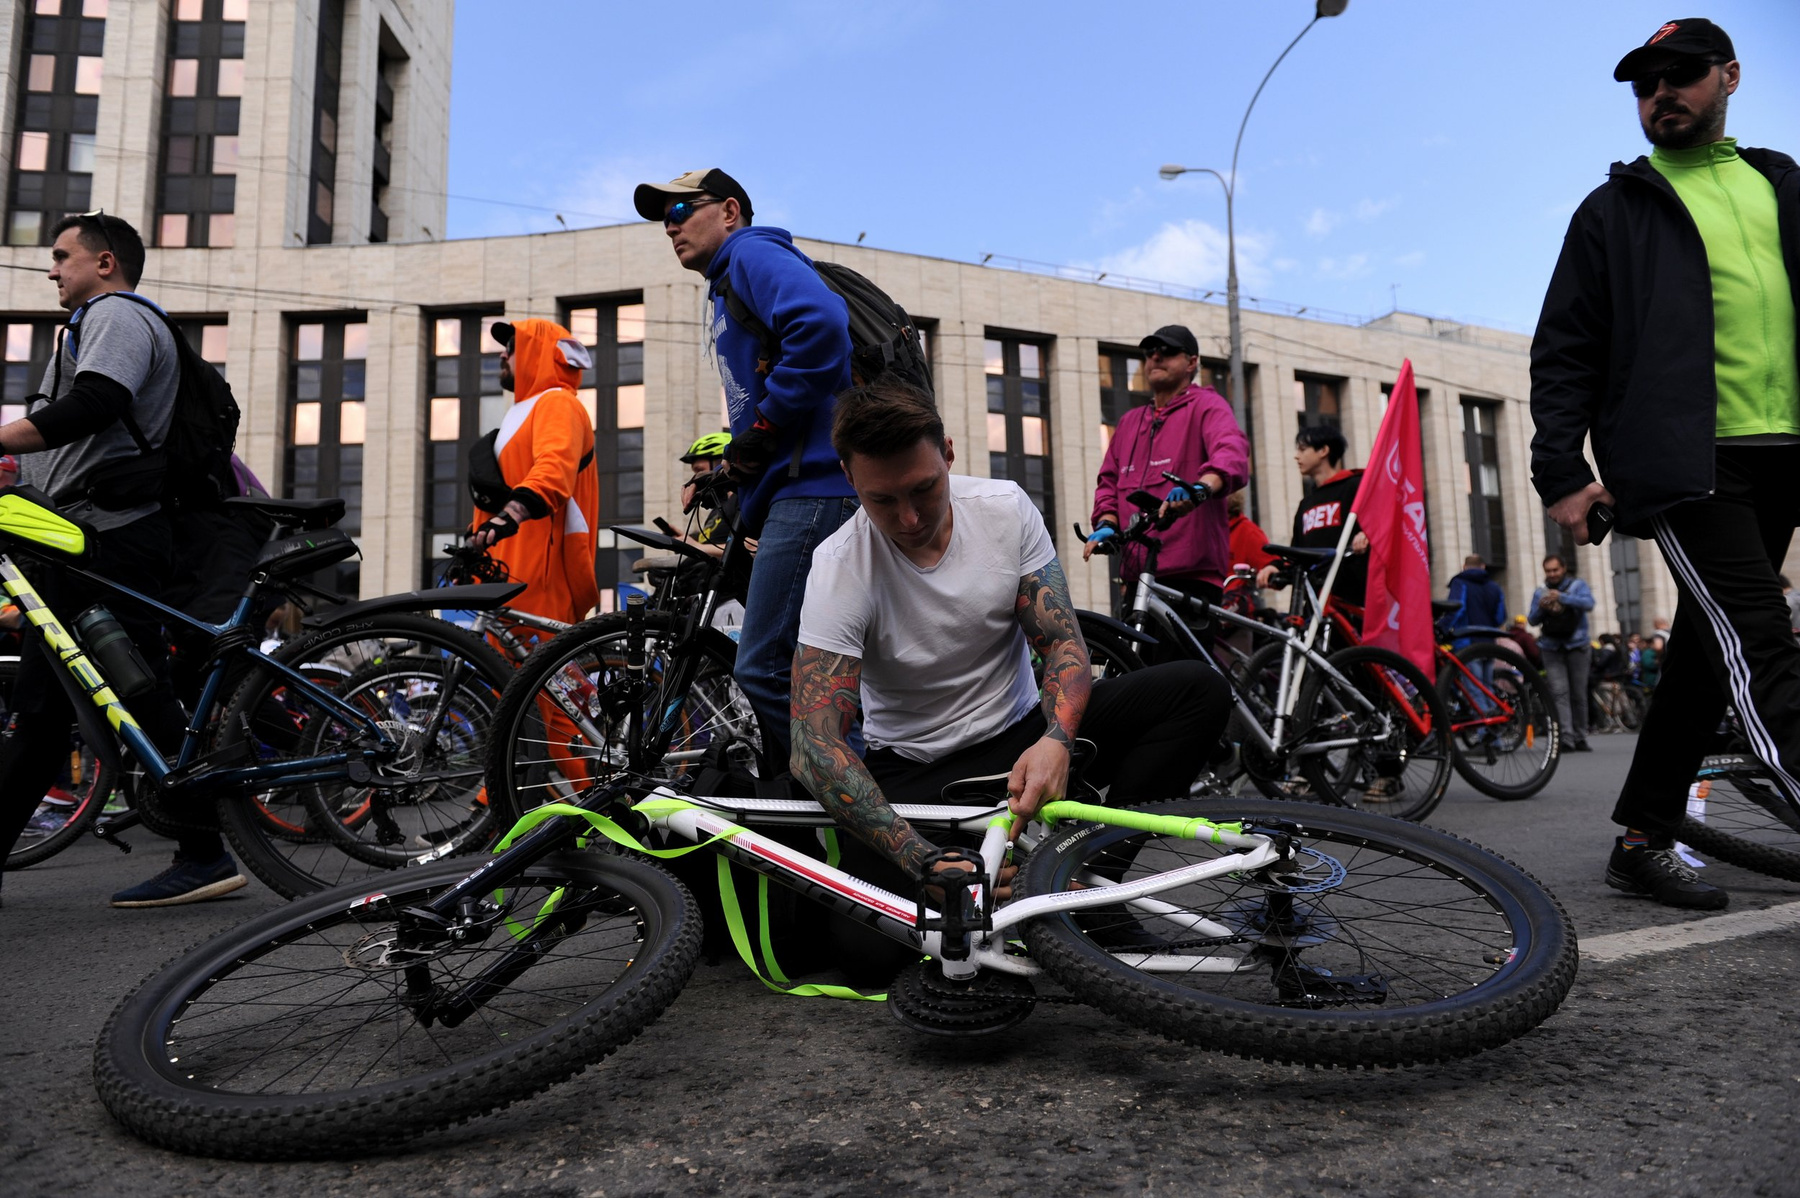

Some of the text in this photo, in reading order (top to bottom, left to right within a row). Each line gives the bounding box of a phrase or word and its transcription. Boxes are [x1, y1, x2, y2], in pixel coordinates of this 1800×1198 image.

[2, 564, 141, 734] TREK
[303, 627, 342, 650] COMP
[1700, 756, 1745, 768] ENDA
[1055, 822, 1106, 854] KENDATIRE.COM
[455, 858, 496, 890] RST
[1048, 887, 1108, 899] PRO RIDER
